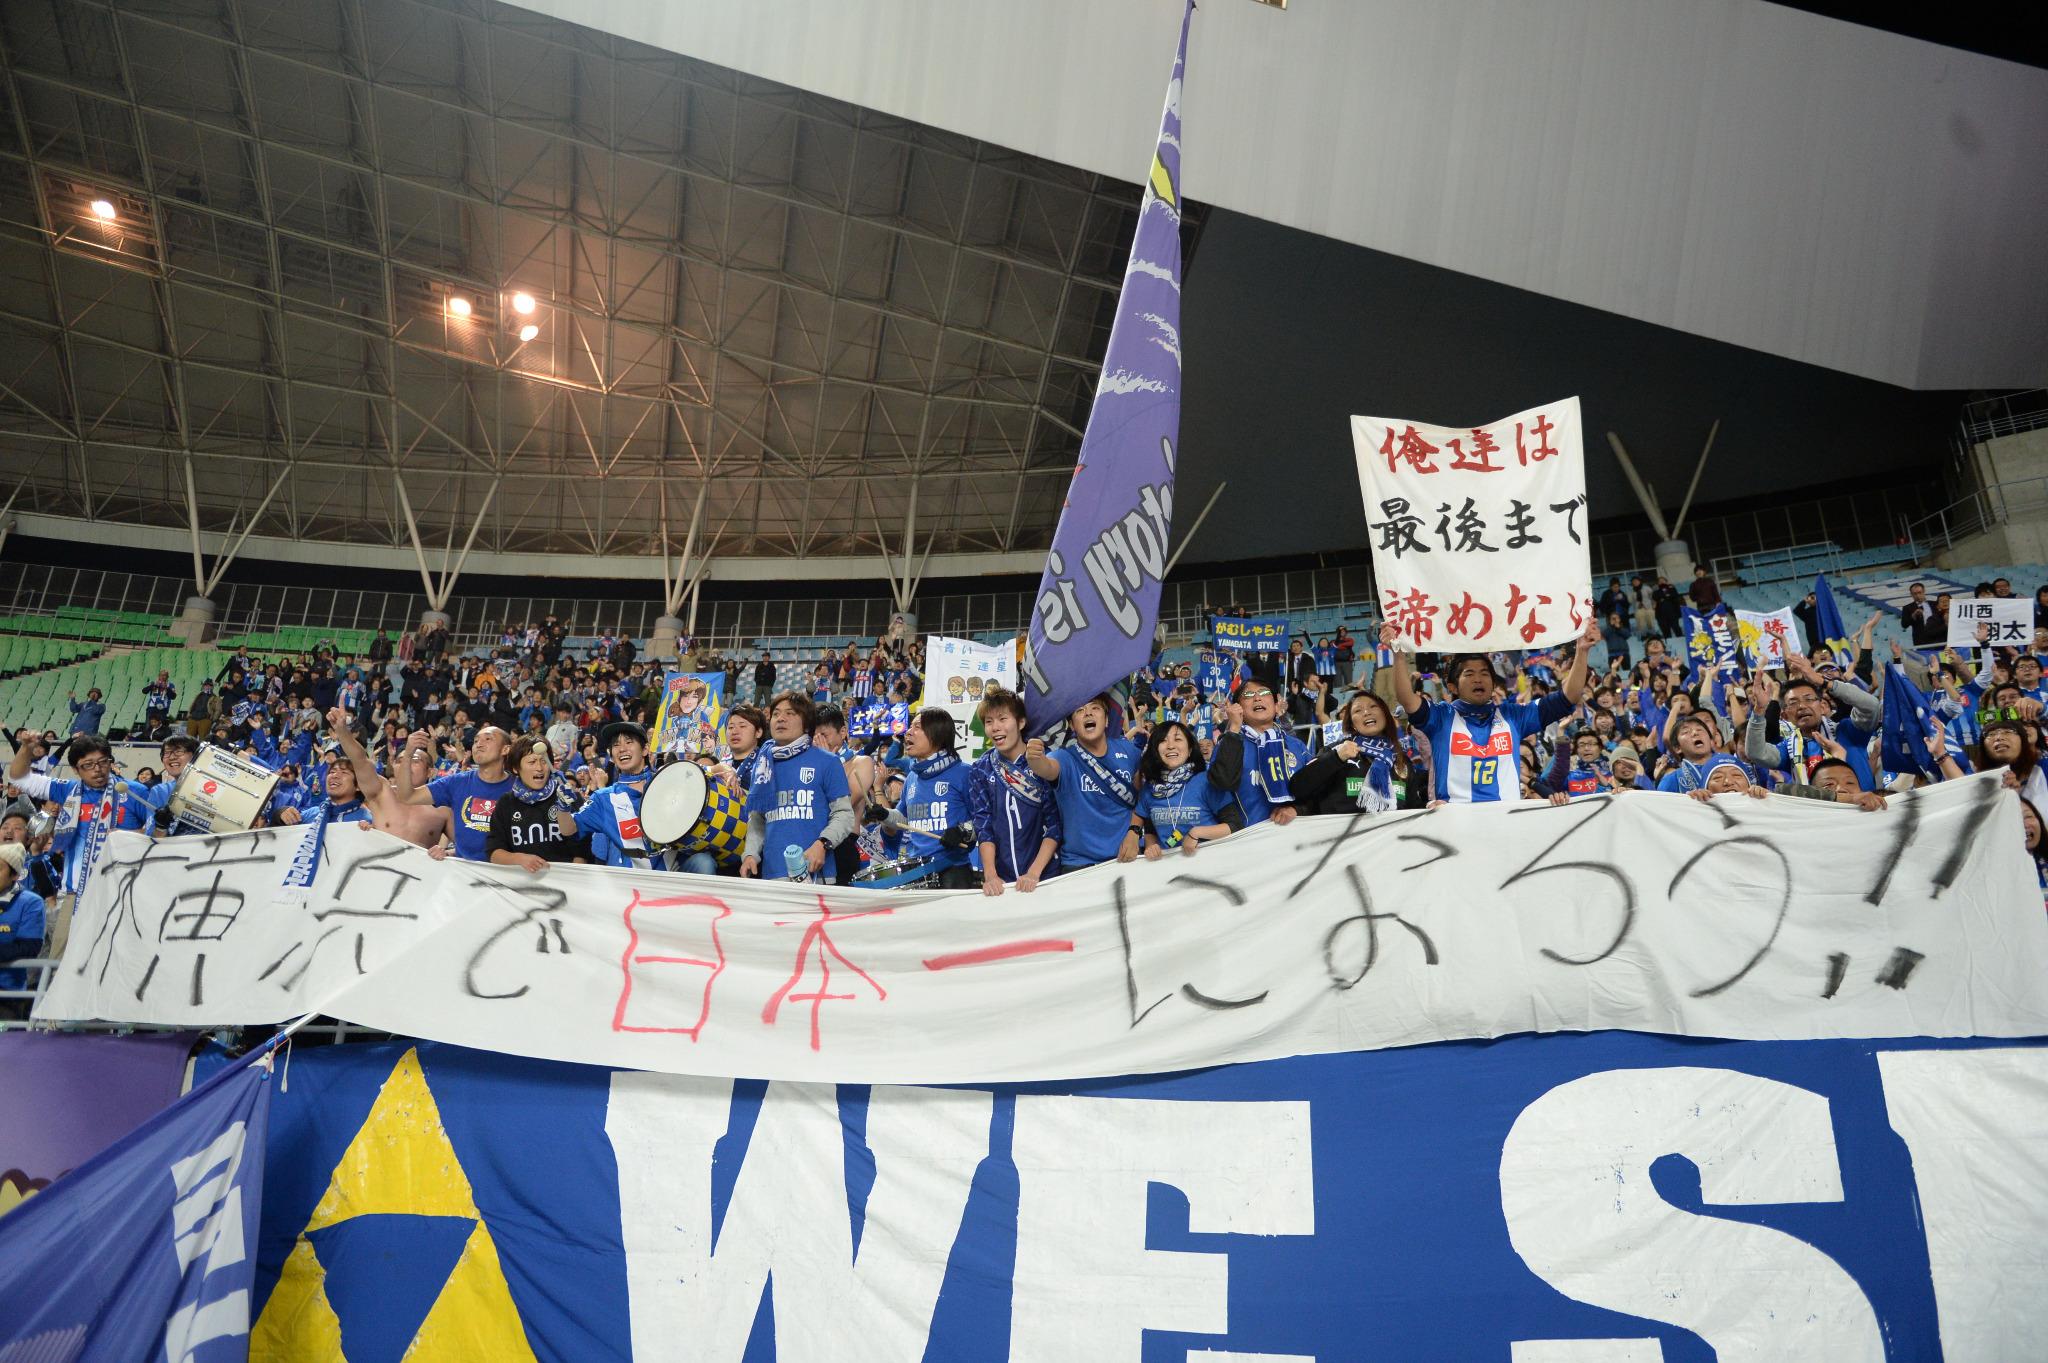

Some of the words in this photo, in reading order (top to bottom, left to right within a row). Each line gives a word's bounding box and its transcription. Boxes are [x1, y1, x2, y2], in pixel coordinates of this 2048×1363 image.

[1379, 414, 1559, 475] 俺達は
[1370, 493, 1588, 560] 最後まで
[1383, 583, 1595, 647] 諦めない
[1958, 604, 1993, 619] 川西
[1215, 622, 1285, 637] がむしゃら!!
[944, 642, 973, 655] 青い
[1218, 639, 1252, 650] YAMAGATA
[1257, 641, 1280, 650] STYLE
[959, 659, 1008, 673] 三連星
[1473, 760, 1498, 785] 12
[796, 789, 815, 806] OF
[930, 801, 949, 818] OF
